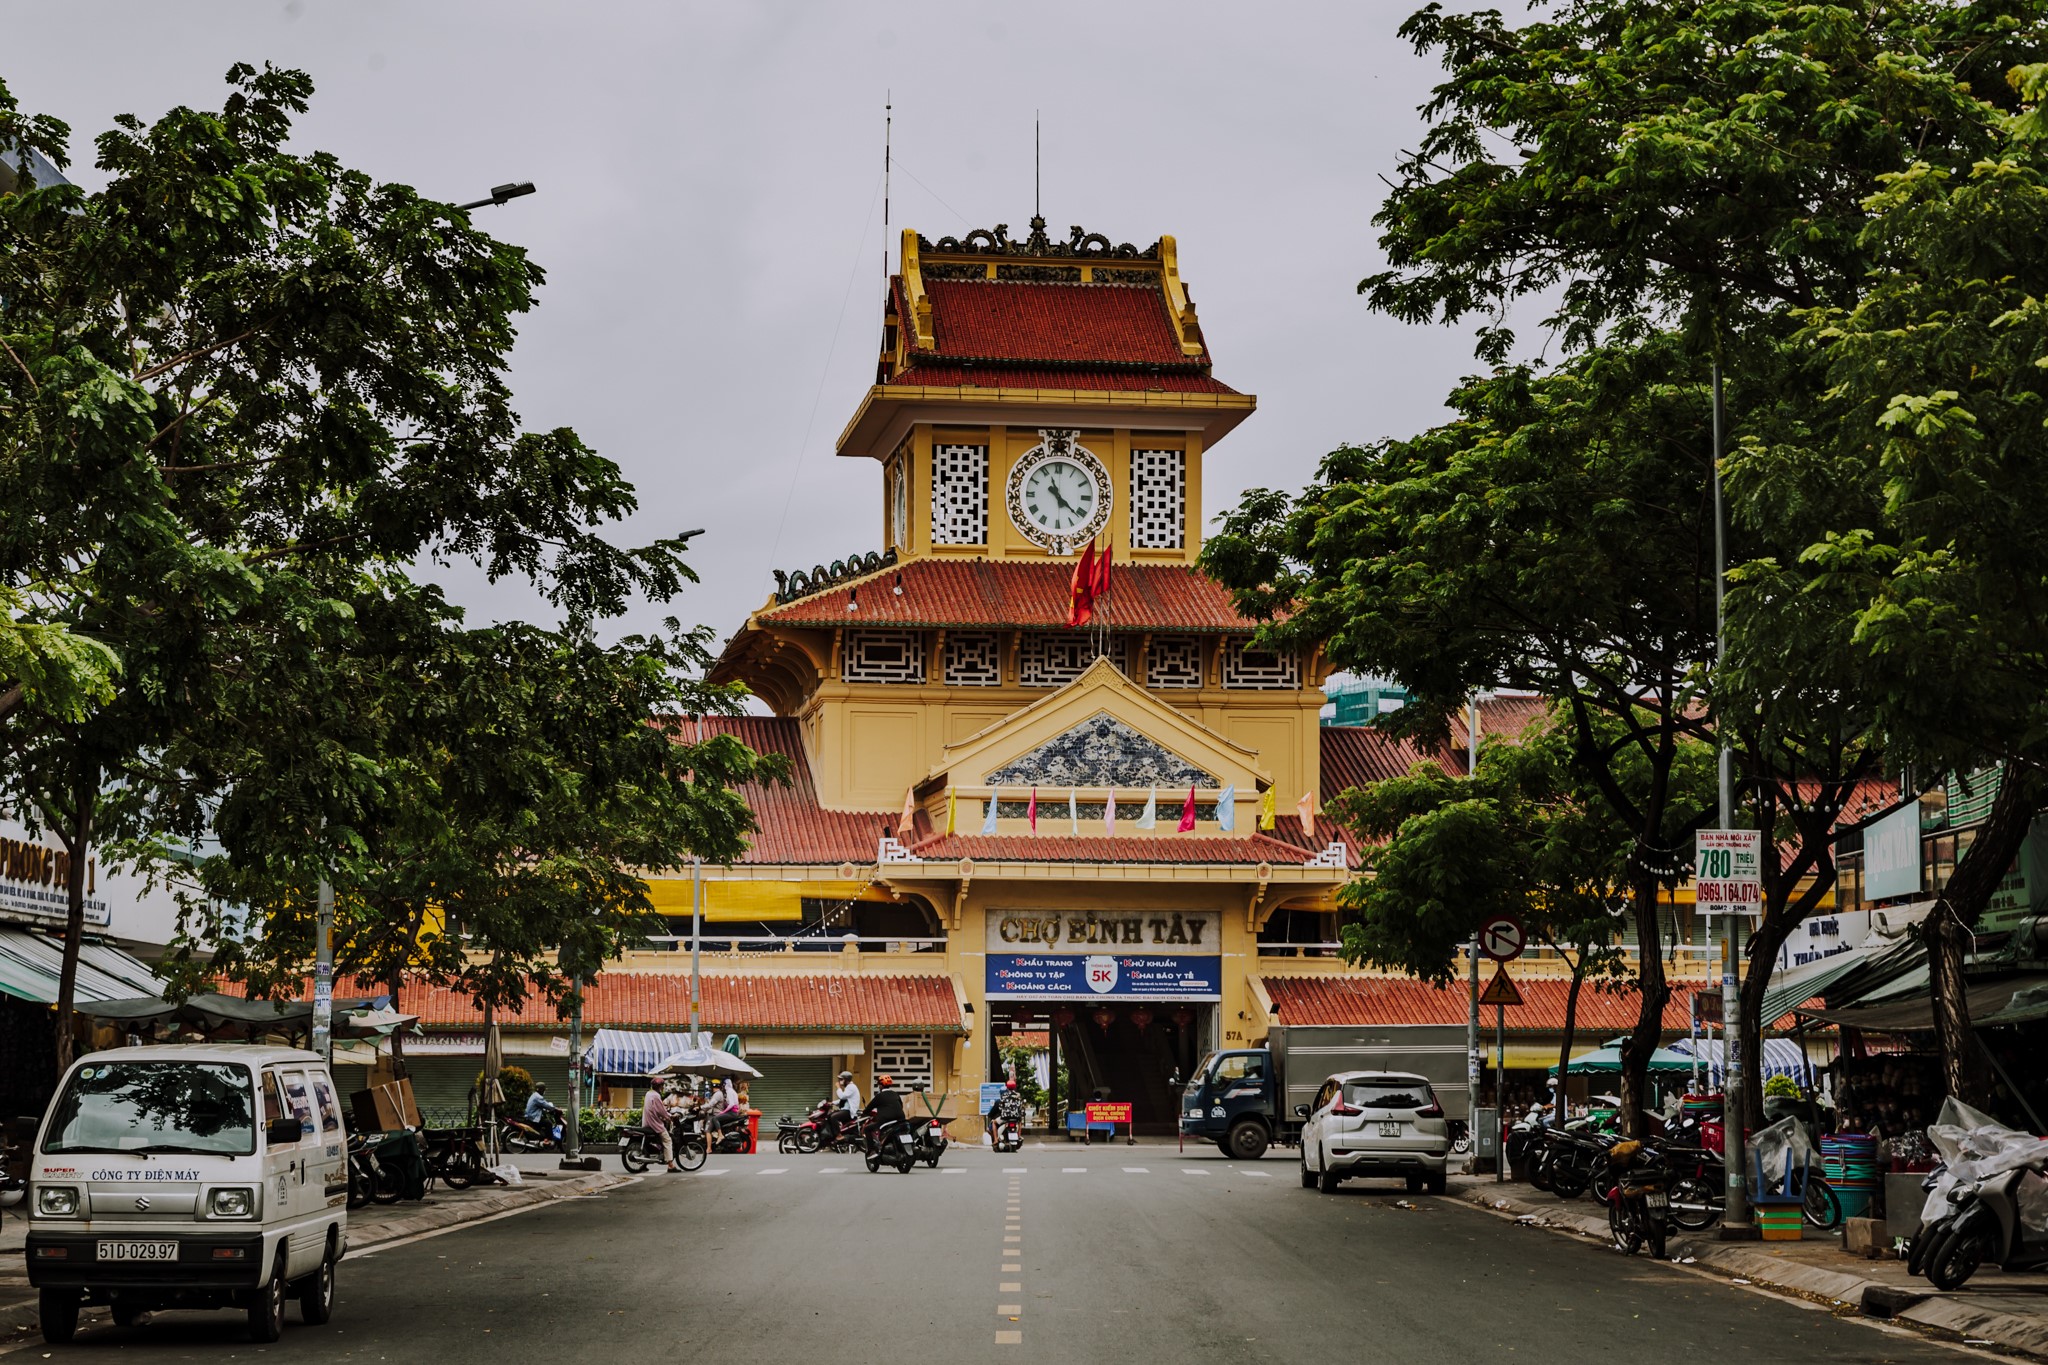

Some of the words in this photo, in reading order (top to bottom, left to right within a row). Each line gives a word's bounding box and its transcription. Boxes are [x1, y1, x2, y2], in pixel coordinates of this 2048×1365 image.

[1716, 832, 1728, 840] NHÀ
[1700, 850, 1731, 878] 780
[1735, 851, 1755, 867] TRIỆU
[1698, 883, 1759, 903] 0969.164.074
[1000, 914, 1061, 949] CHỢ
[1067, 912, 1144, 944] BÌNH
[1148, 913, 1207, 945] TÂY
[1016, 958, 1044, 967] KHẨU
[1123, 959, 1145, 967] KHỬ
[1147, 959, 1177, 967] KHUẨN
[1000, 970, 1033, 978] KHÔNG
[1049, 971, 1065, 979] TẬP
[1092, 970, 1111, 982] 5K
[1131, 971, 1154, 979] KHAI
[1006, 981, 1046, 990] KHOẢNG
[1226, 1031, 1243, 1040] 57A
[92, 1169, 123, 1180] CÔNG
[127, 1171, 141, 1180] TY
[145, 1169, 173, 1182] ĐIỆN
[174, 1168, 200, 1180] MÁY
[99, 1243, 176, 1259] 51D-029.97
